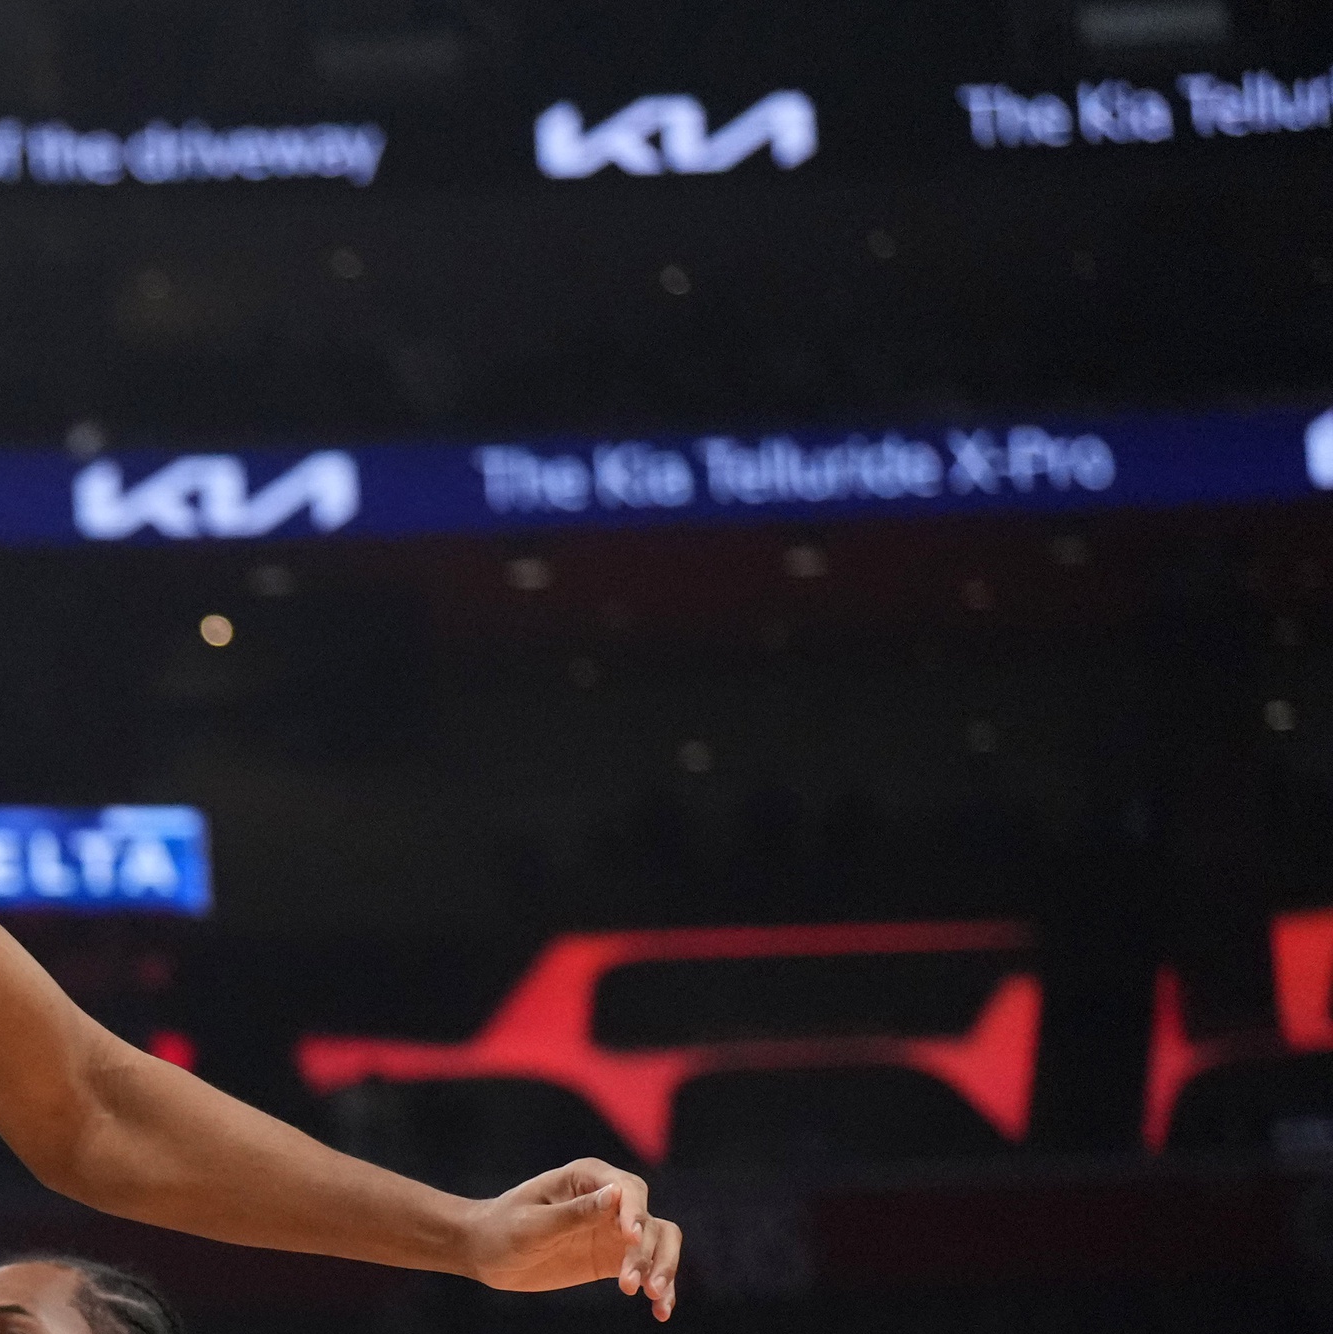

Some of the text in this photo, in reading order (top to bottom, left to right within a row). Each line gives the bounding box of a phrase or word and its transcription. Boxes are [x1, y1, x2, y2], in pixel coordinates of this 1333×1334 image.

[955, 83, 1073, 148] The
[1077, 78, 1173, 144] Kia
[25, 117, 123, 185] the
[123, 117, 386, 188] driveway
[472, 443, 591, 512] The
[593, 440, 695, 509] Kia
[695, 431, 943, 506] Telluride
